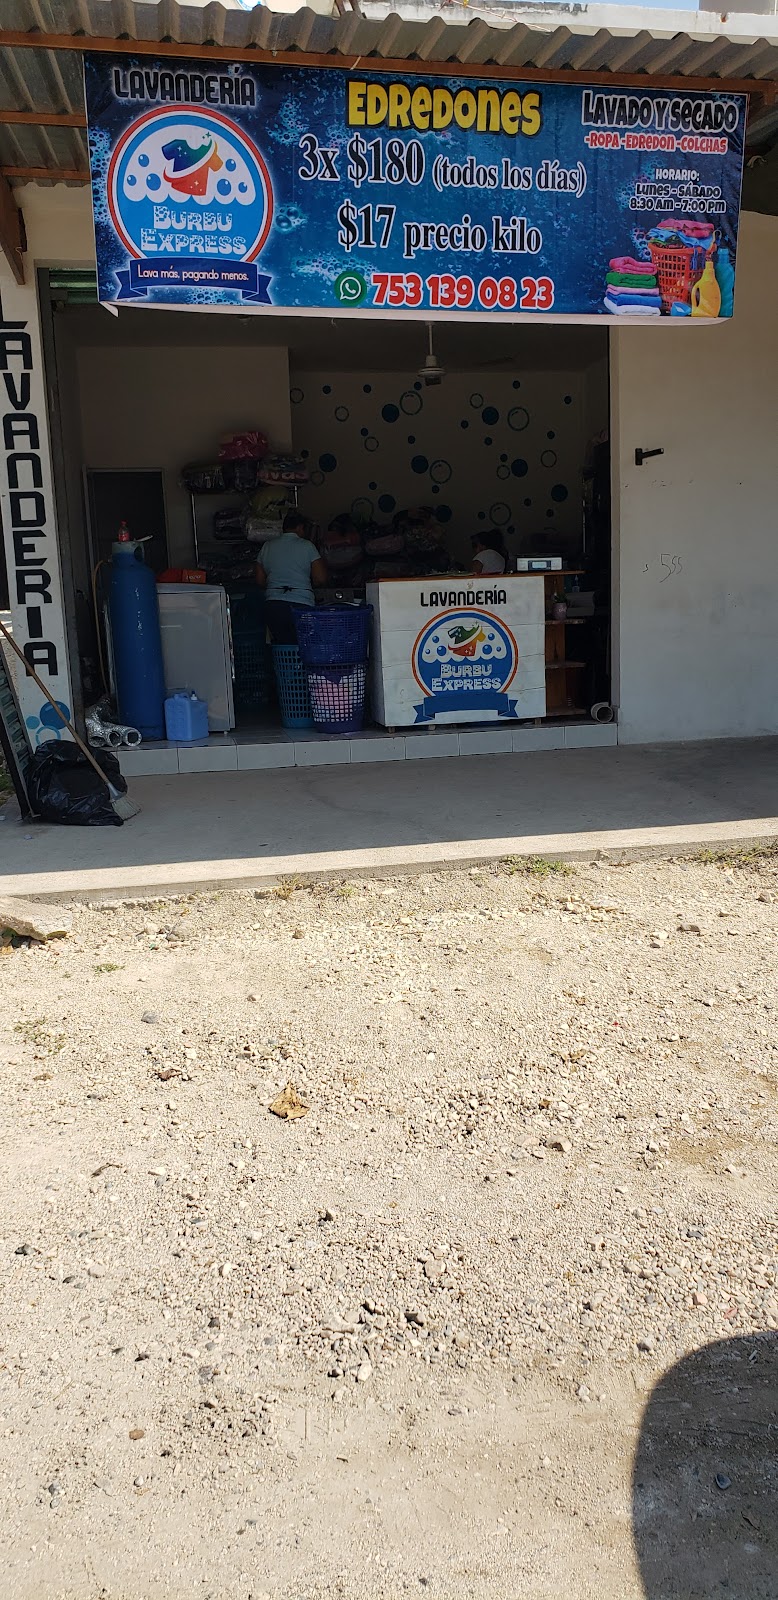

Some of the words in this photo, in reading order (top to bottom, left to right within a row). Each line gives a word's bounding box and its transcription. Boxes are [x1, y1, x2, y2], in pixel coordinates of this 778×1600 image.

[113, 66, 256, 107] LAVANDERÍA
[583, 91, 652, 126] LAVADO
[654, 98, 668, 129] Y
[299, 134, 340, 181] 3x
[347, 132, 424, 187] $180
[432, 156, 498, 191] (todos
[502, 157, 532, 190] los
[537, 160, 587, 198] días)
[656, 169, 700, 182] HORARIO:
[678, 183, 721, 198] SÁBADO
[630, 199, 654, 211] 8:30
[682, 200, 706, 212] 7:00
[153, 205, 232, 231] BURBU
[338, 200, 395, 251] $17
[404, 214, 486, 258] precio
[492, 216, 542, 254] kilo
[140, 227, 246, 255] EXPRESS
[137, 264, 160, 280] Lava
[182, 269, 219, 283] pagando
[221, 271, 249, 282] menos.
[372, 274, 422, 306] 753
[427, 275, 474, 307] 139
[479, 276, 518, 309] 08
[521, 277, 555, 309] 23
[420, 585, 507, 607] LAVANDERÍA
[440, 664, 492, 678] BURBU
[431, 677, 502, 692] EXPRESS
